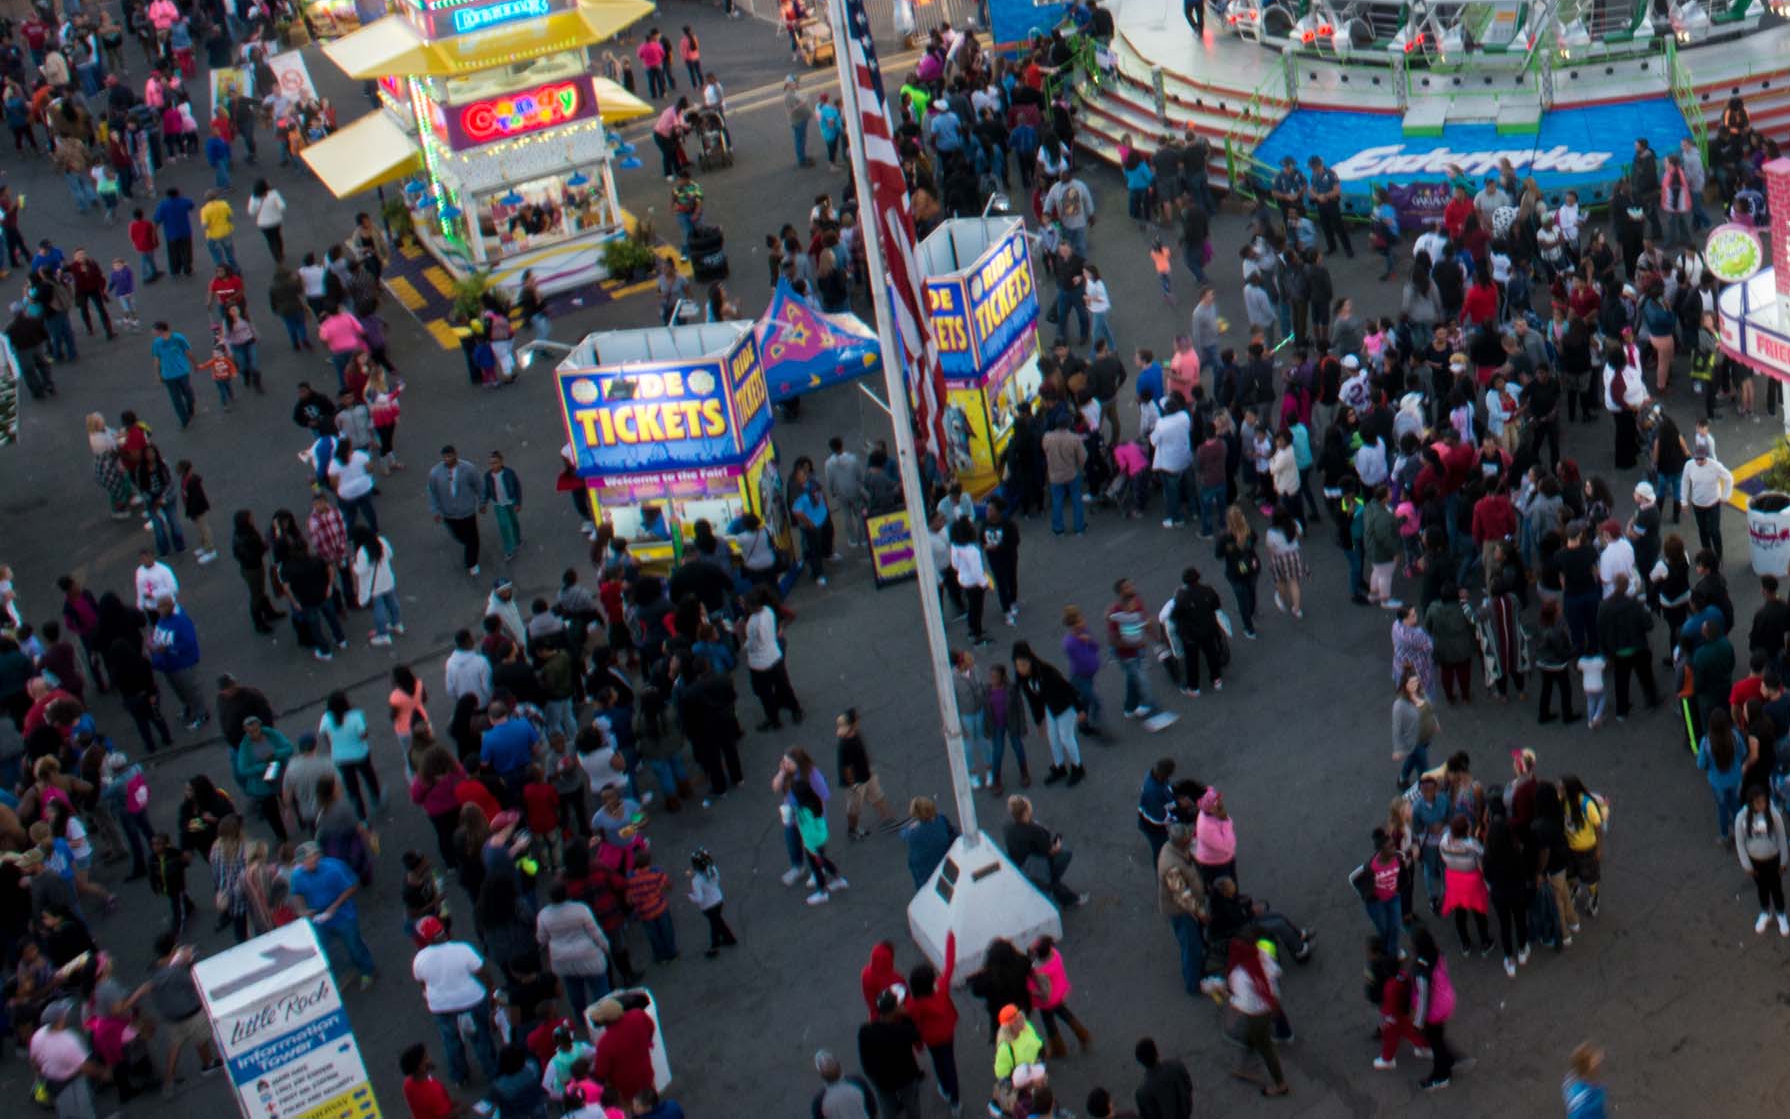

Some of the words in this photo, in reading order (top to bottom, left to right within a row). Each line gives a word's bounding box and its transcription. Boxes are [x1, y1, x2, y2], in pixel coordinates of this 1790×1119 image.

[1331, 144, 1613, 181] Enterprise
[981, 243, 1014, 291] RIDE
[975, 259, 1032, 342] TICKETS
[732, 340, 756, 382] RIDE
[735, 367, 766, 427] TICKETS
[575, 398, 727, 447] TICKETS
[604, 475, 658, 488] Welcome
[662, 473, 675, 482] to
[678, 471, 698, 480] the
[701, 468, 728, 479] Fair!
[231, 1004, 277, 1047] Little
[278, 980, 330, 1021] Rock
[237, 1014, 340, 1070] Information
[258, 1041, 311, 1072] Tower
